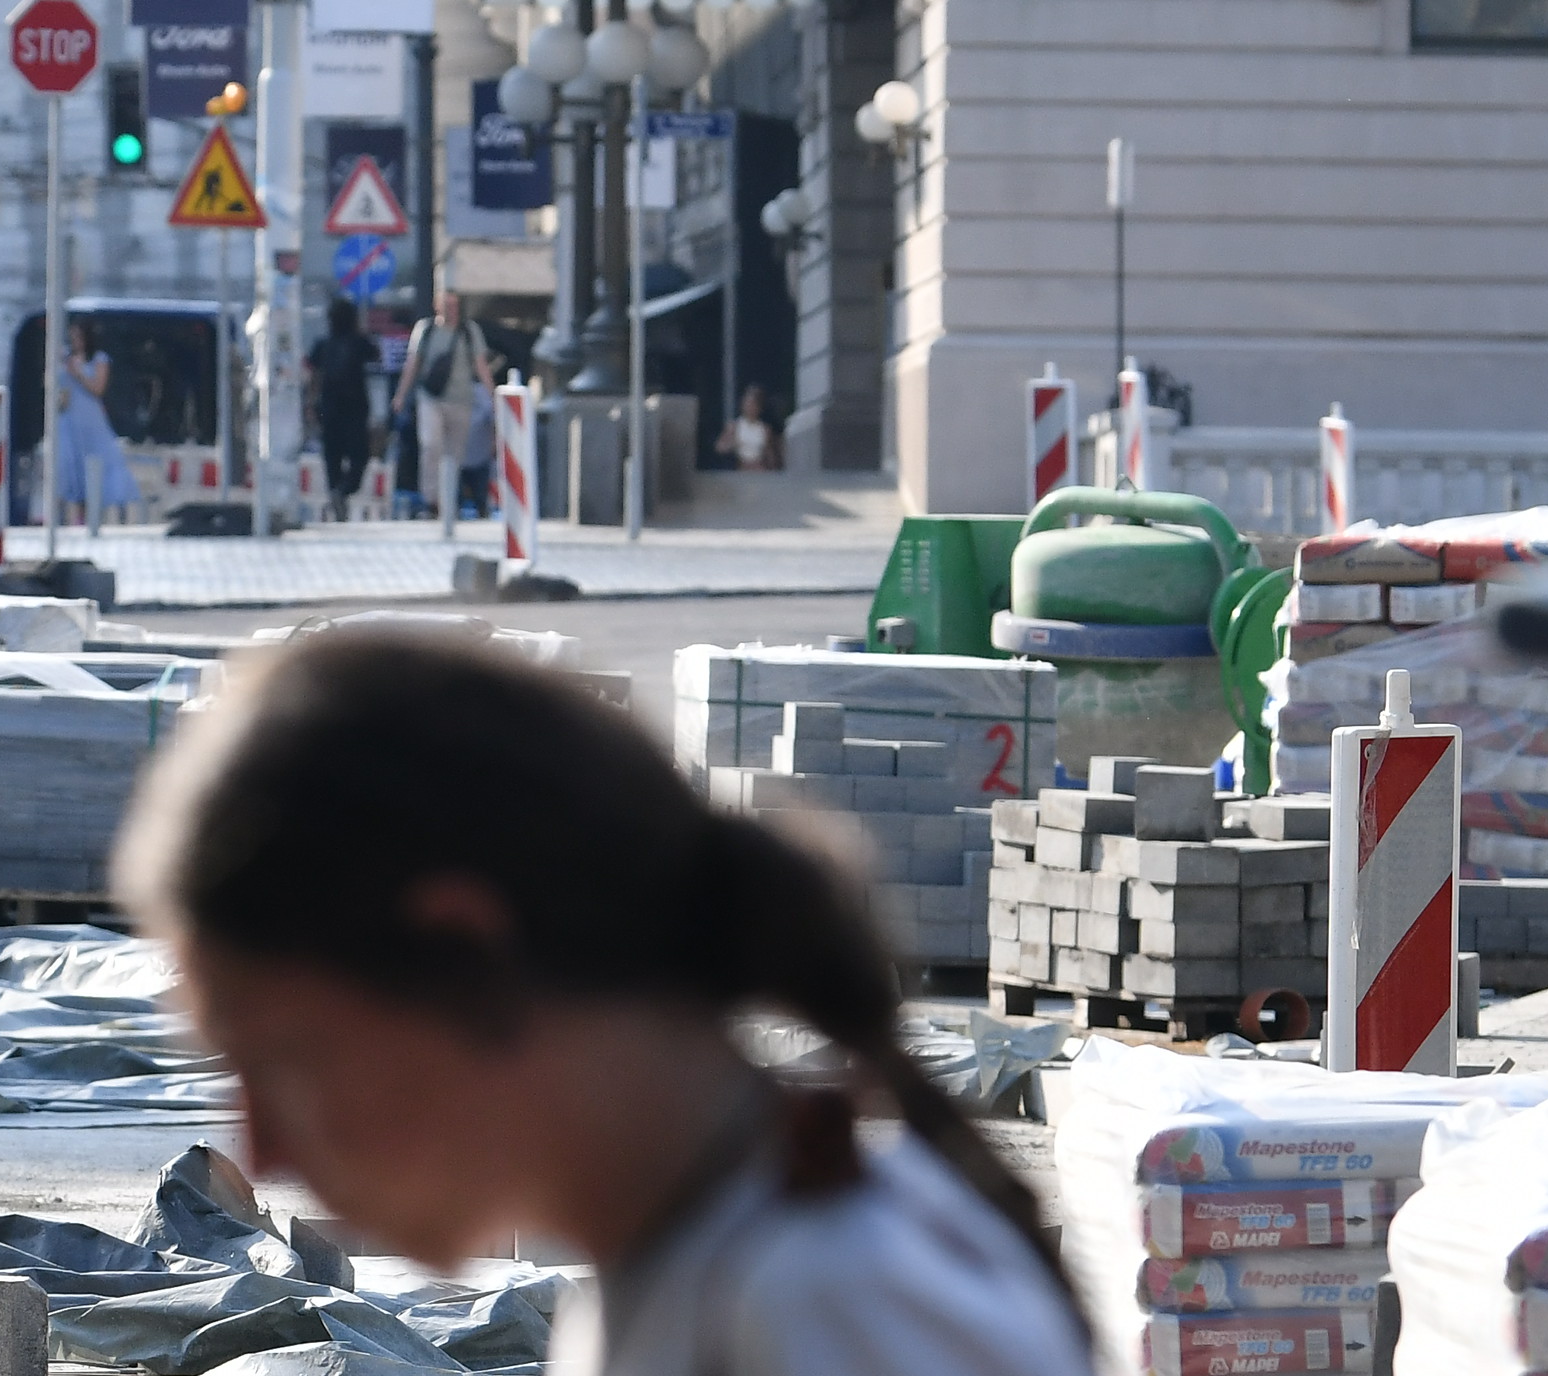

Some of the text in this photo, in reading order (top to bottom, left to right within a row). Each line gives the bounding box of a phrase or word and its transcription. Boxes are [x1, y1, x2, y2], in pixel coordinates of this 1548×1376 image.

[19, 27, 91, 64] STOP
[982, 724, 1020, 795] 2
[1239, 1139, 1356, 1158] Mapestone
[1298, 1154, 1374, 1172] TFB 60
[1232, 1232, 1281, 1248] MAPEI
[1241, 1270, 1359, 1288] Mapestone
[1301, 1285, 1376, 1302] TFB 60
[1231, 1357, 1280, 1373] MAPEI
